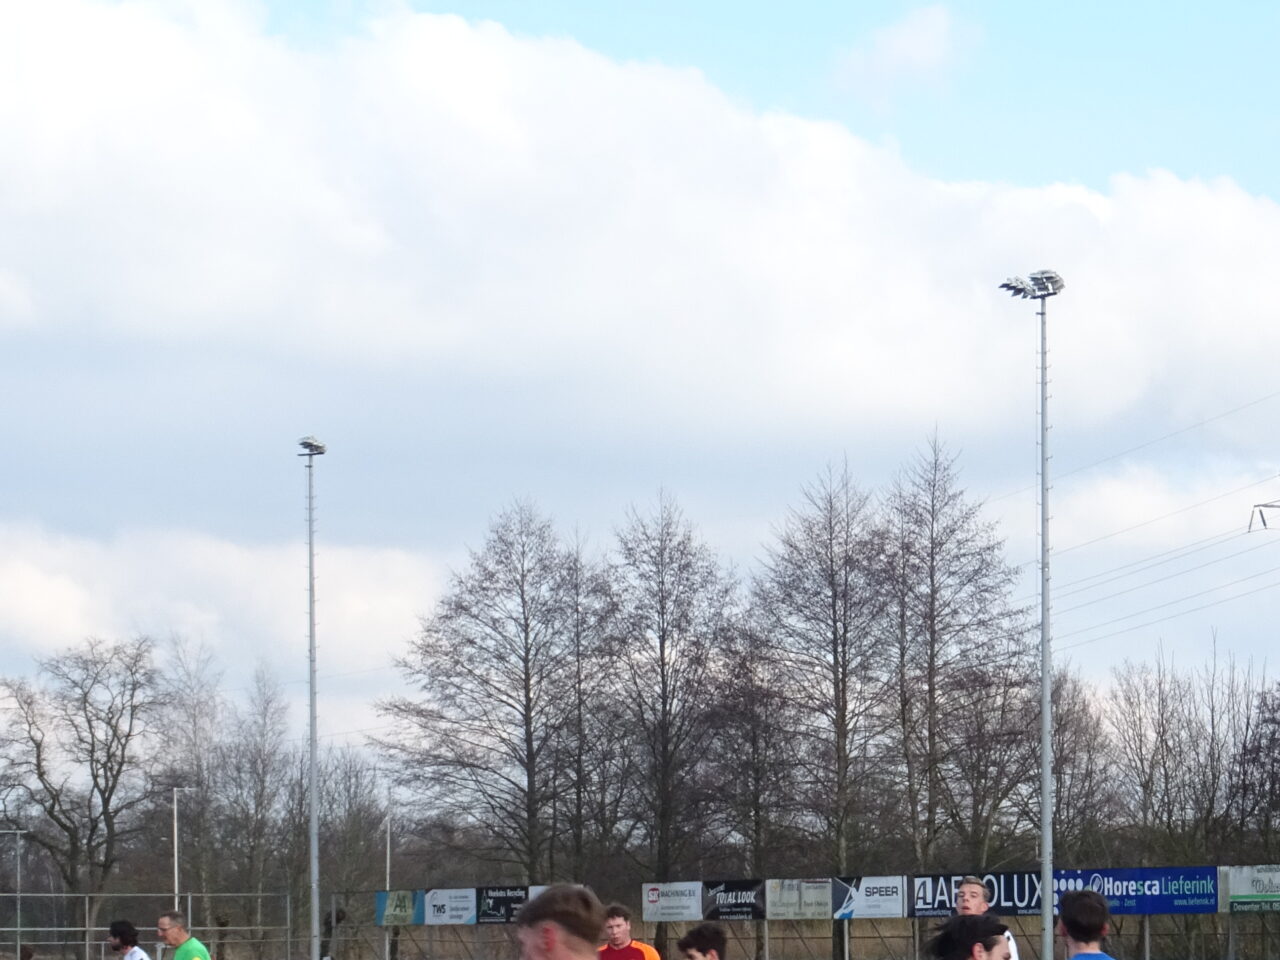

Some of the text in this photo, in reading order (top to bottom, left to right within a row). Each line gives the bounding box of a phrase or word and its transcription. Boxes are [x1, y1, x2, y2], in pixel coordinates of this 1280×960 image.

[864, 886, 899, 898] SPEER
[933, 873, 1043, 909] AEOLUX
[1104, 874, 1215, 896] Horesca Lieferink
[737, 890, 756, 904] LOOK
